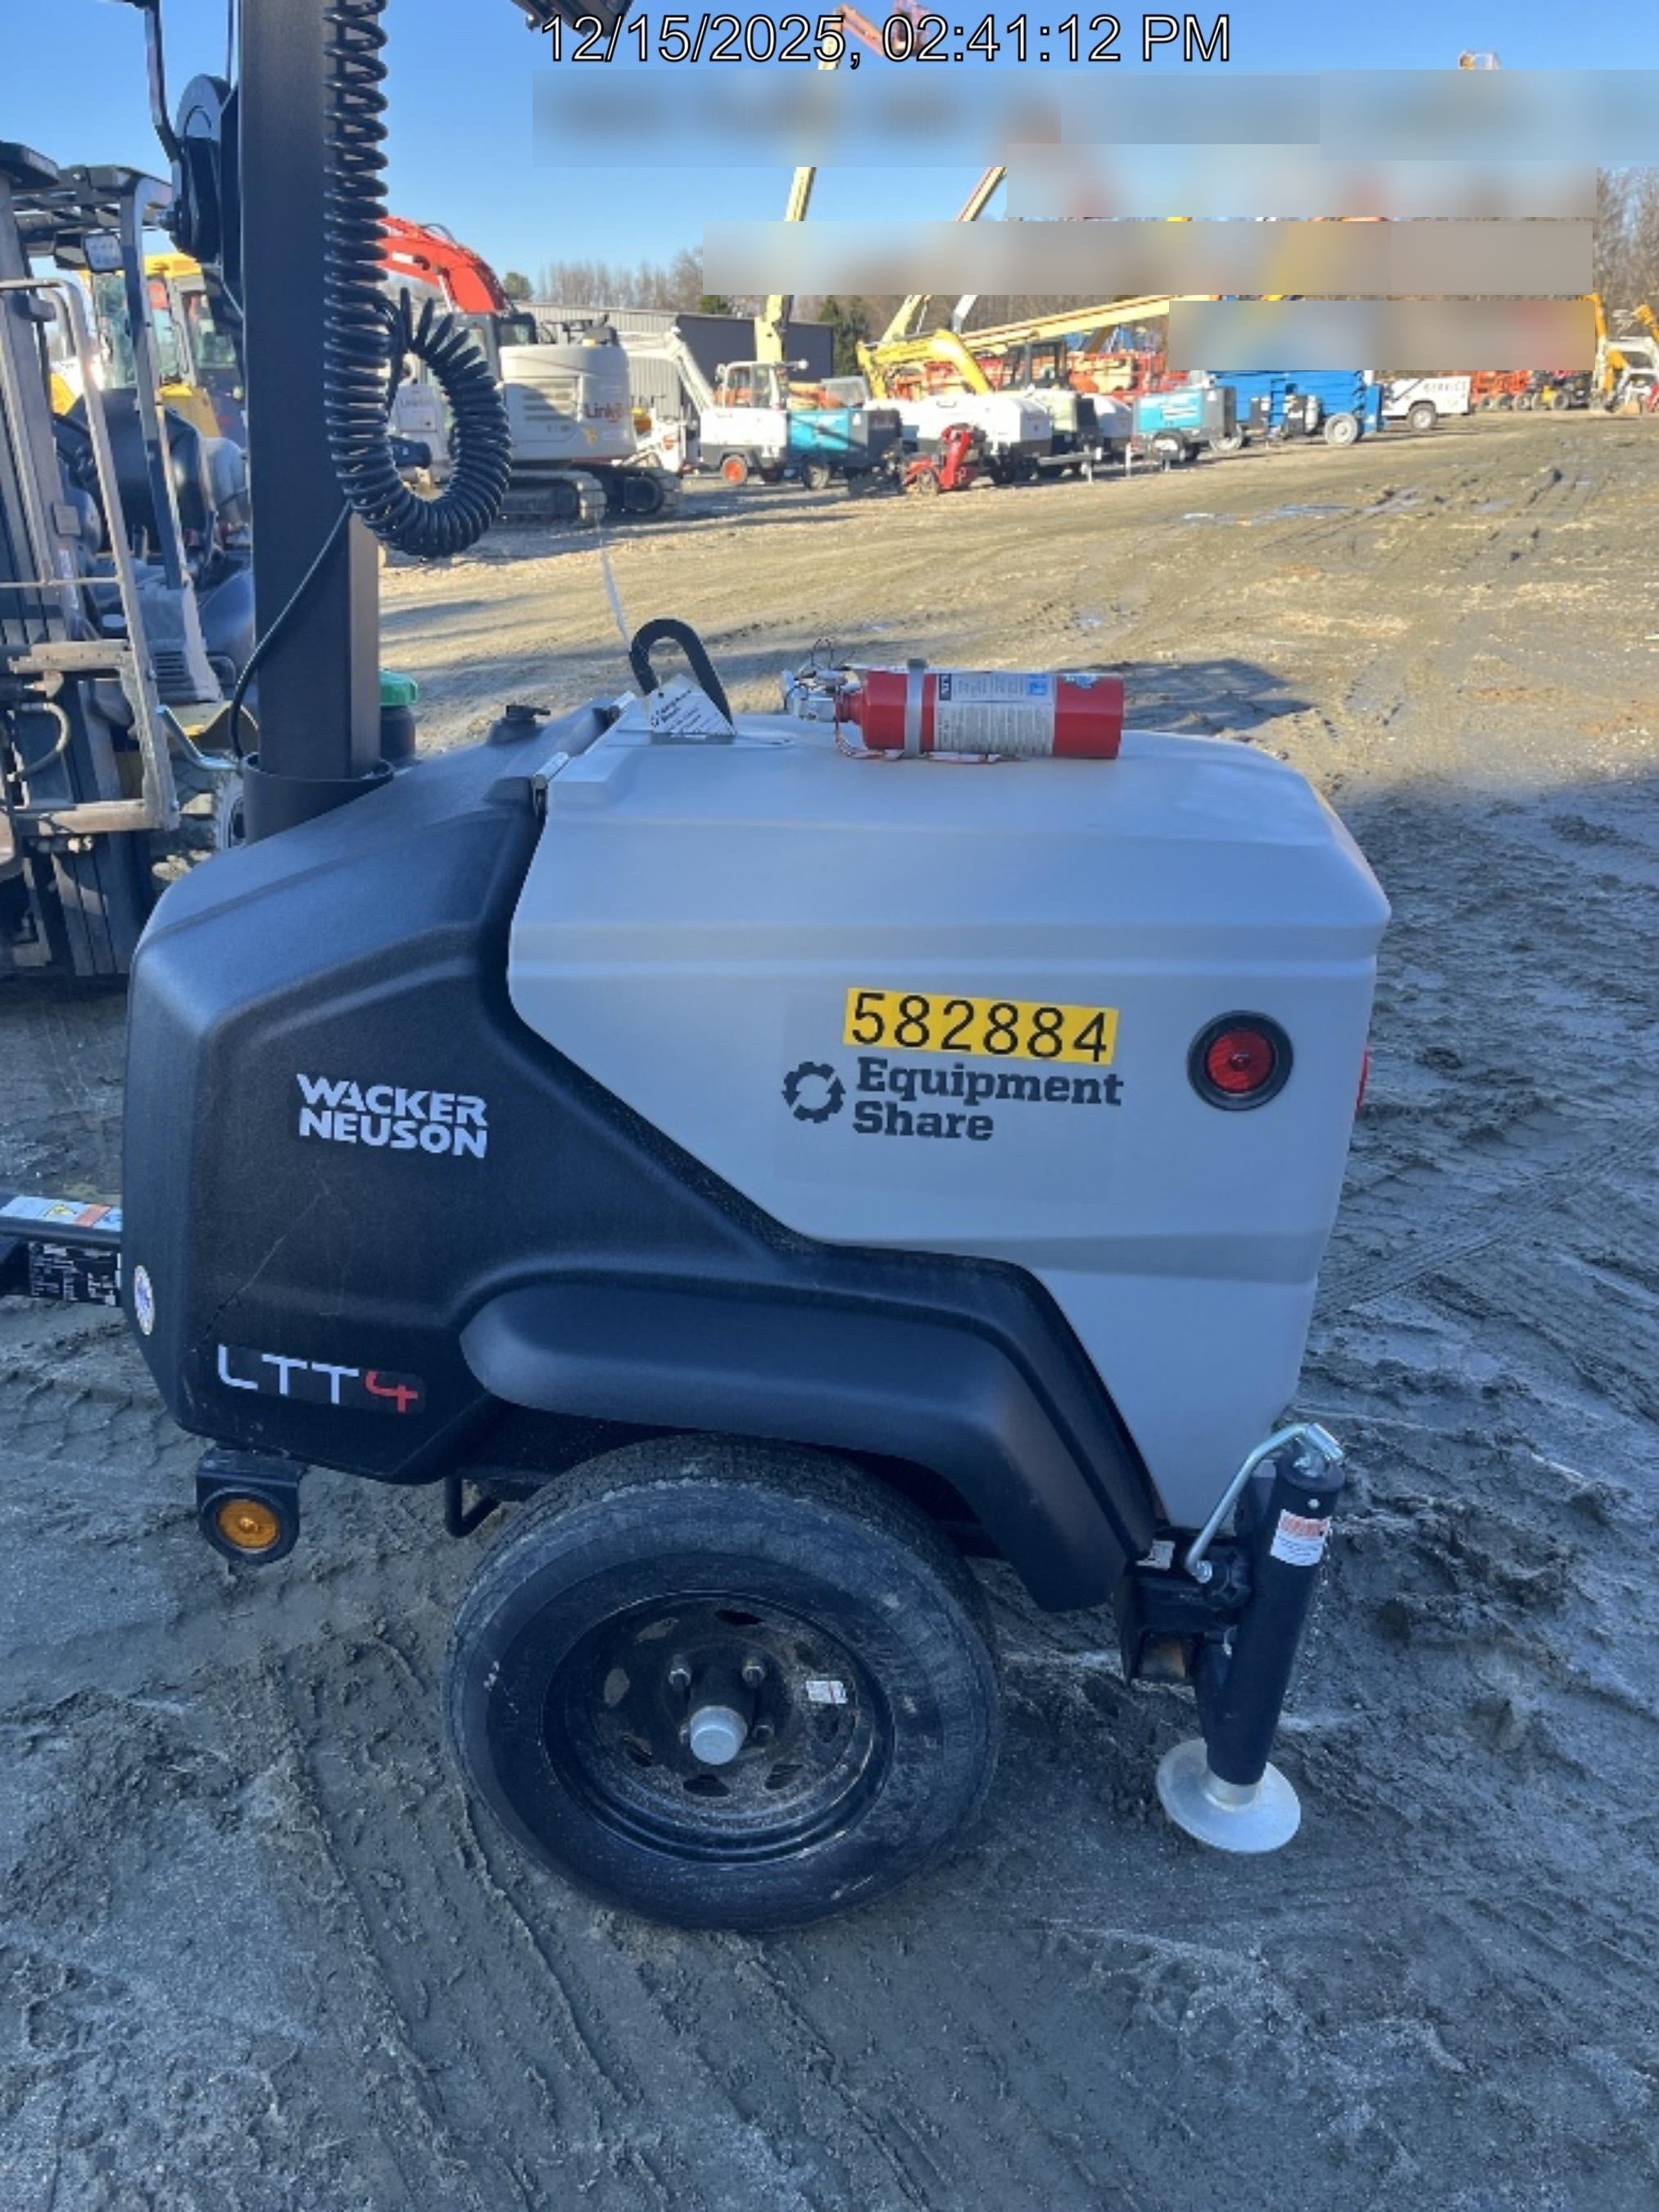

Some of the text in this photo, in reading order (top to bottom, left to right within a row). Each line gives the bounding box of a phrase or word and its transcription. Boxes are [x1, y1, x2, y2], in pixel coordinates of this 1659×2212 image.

[852, 991, 1107, 1063] 582884
[296, 1073, 489, 1126] WACKER
[857, 1056, 1124, 1107] Equipment
[298, 1107, 489, 1159] NEUSON
[852, 1100, 994, 1141] Share
[217, 1344, 419, 1413] LTT4
